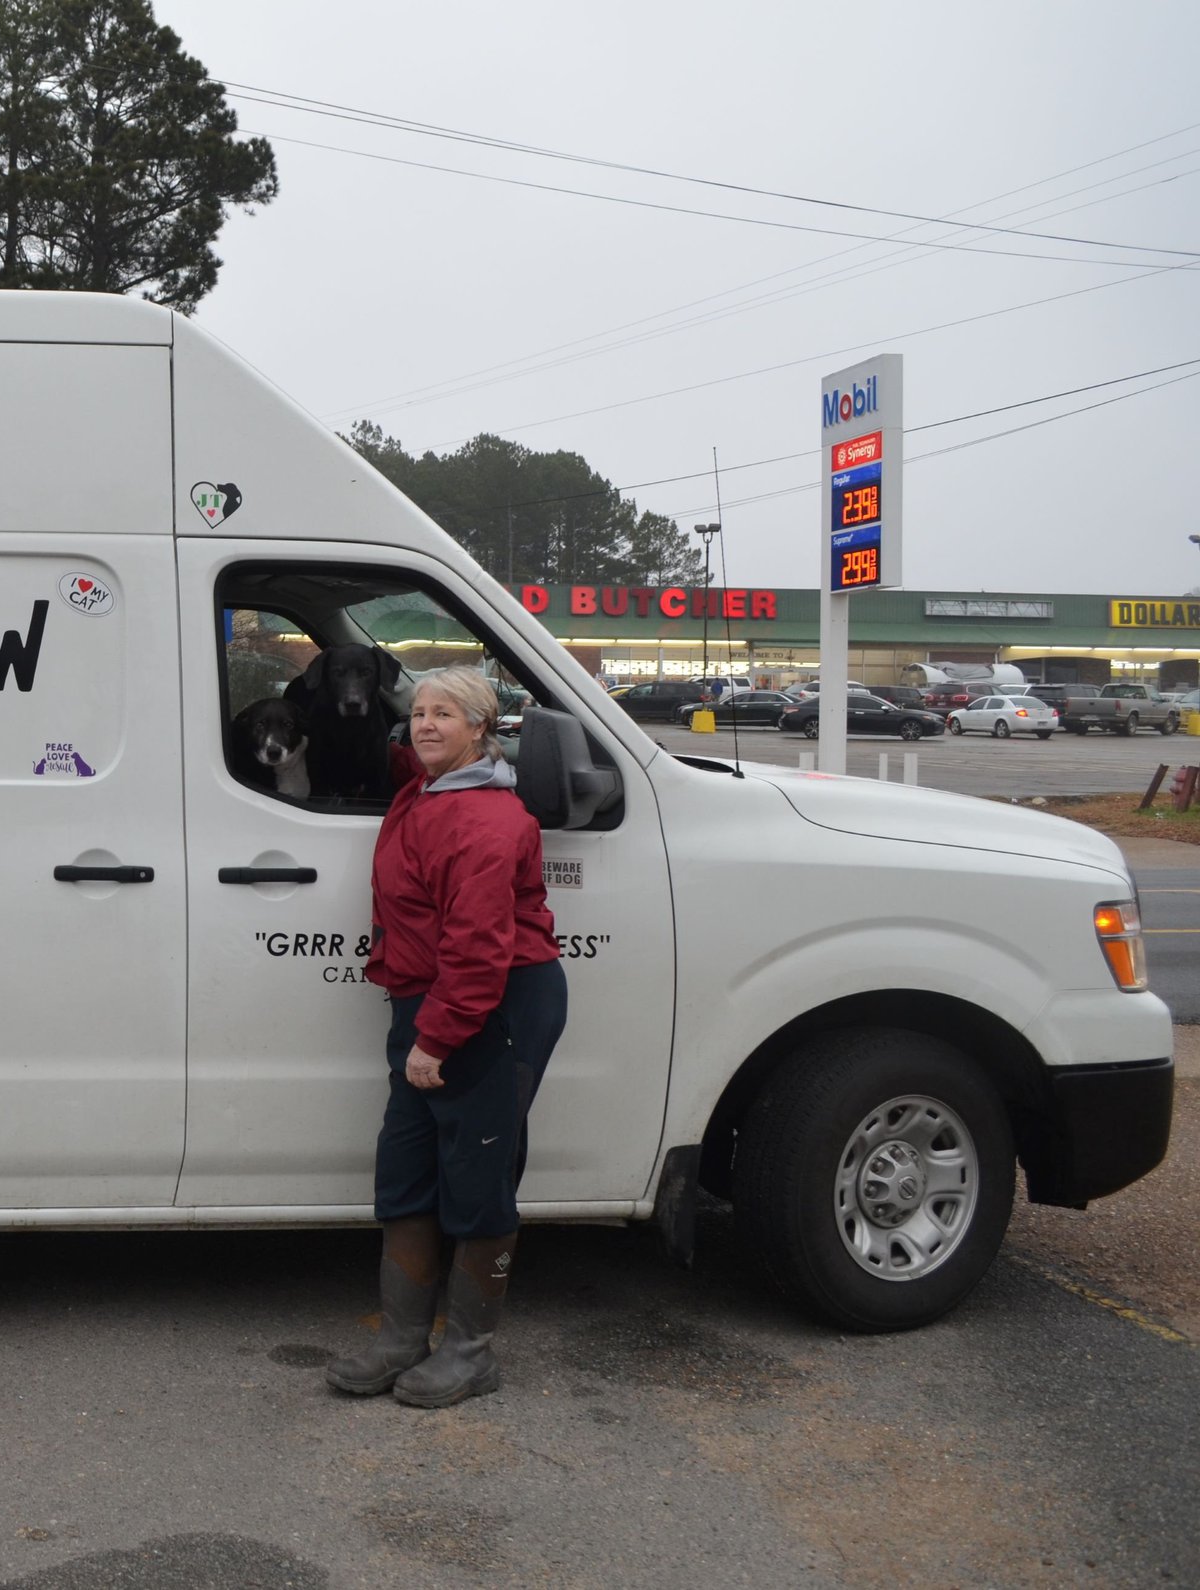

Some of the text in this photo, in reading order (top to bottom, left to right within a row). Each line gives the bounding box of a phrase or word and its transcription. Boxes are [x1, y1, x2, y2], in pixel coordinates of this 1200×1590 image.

[823, 375, 877, 427] Mobil
[847, 443, 875, 462] Synergy
[197, 494, 223, 508] JT
[71, 577, 109, 602] I MY
[69, 591, 97, 610] CAT
[570, 585, 777, 618] BUTCHER
[1119, 603, 1200, 625] DOLLAR
[46, 743, 72, 751] PEACE
[47, 752, 70, 761] LOVE
[542, 861, 581, 873] BEWARE
[556, 874, 581, 885] DOG
[255, 932, 610, 959] "GRRR & ESS"
